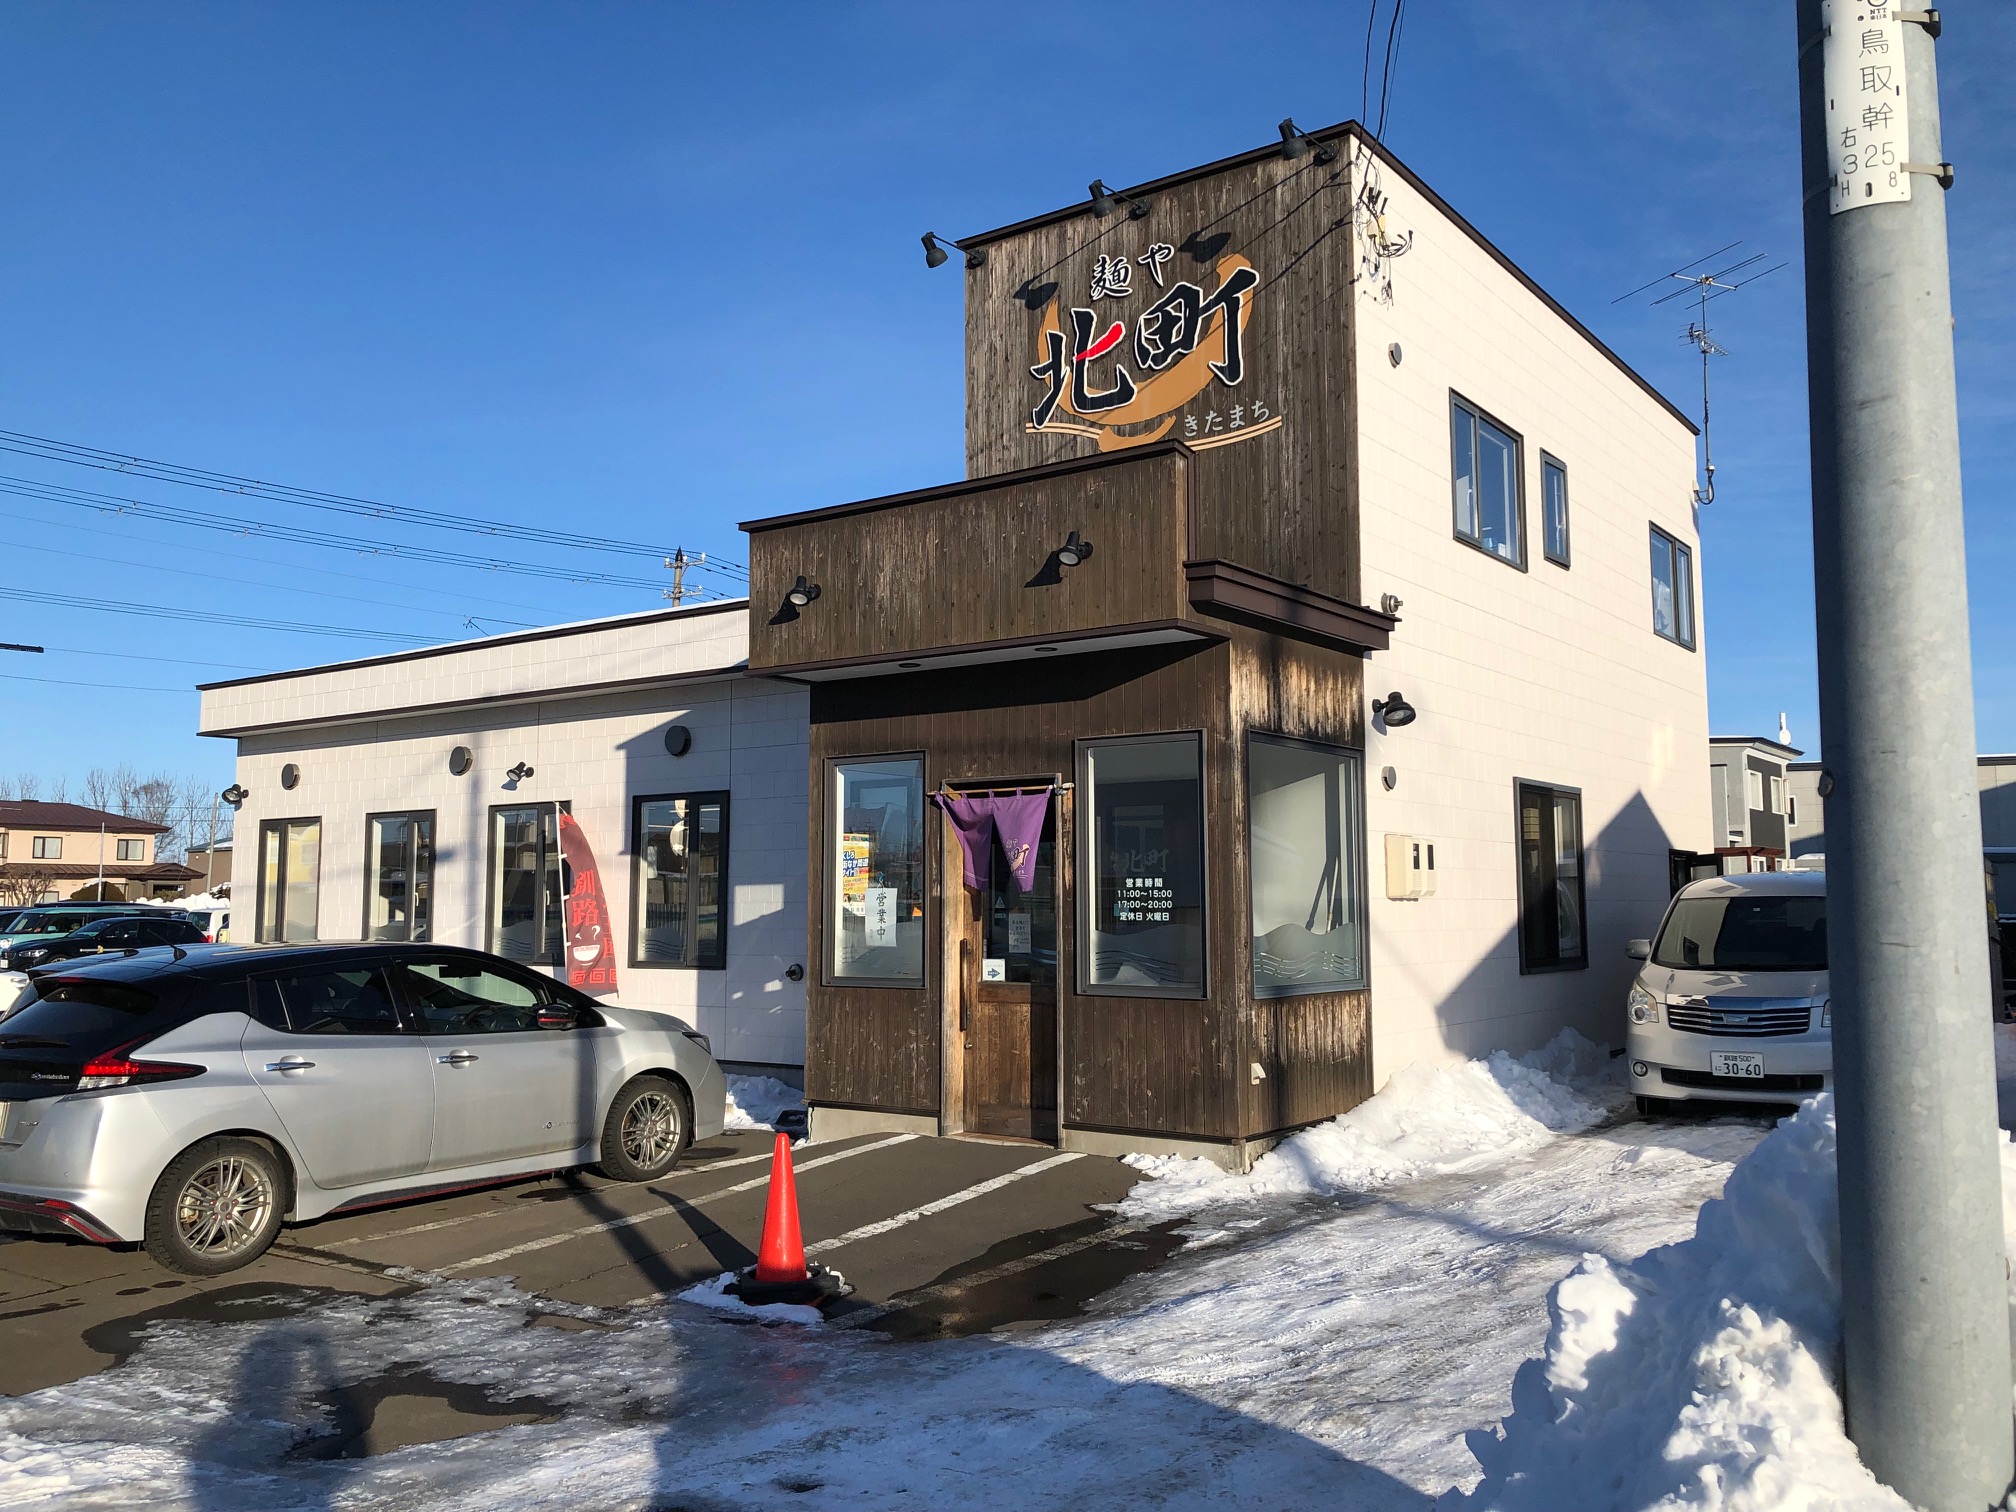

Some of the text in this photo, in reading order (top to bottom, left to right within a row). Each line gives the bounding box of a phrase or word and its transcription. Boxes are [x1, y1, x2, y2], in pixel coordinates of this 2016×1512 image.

[1858, 28, 1894, 132] 鳥取幹
[1090, 243, 1174, 301] 麺や
[1030, 266, 1260, 429] 北町
[1184, 400, 1270, 437] きたまち
[571, 870, 600, 928] 釧路
[1125, 878, 1163, 888] 営業時間
[875, 891, 888, 942] 営業中
[1119, 912, 1170, 921] 定休日 火曜日
[1723, 1062, 1761, 1076] 30-60
